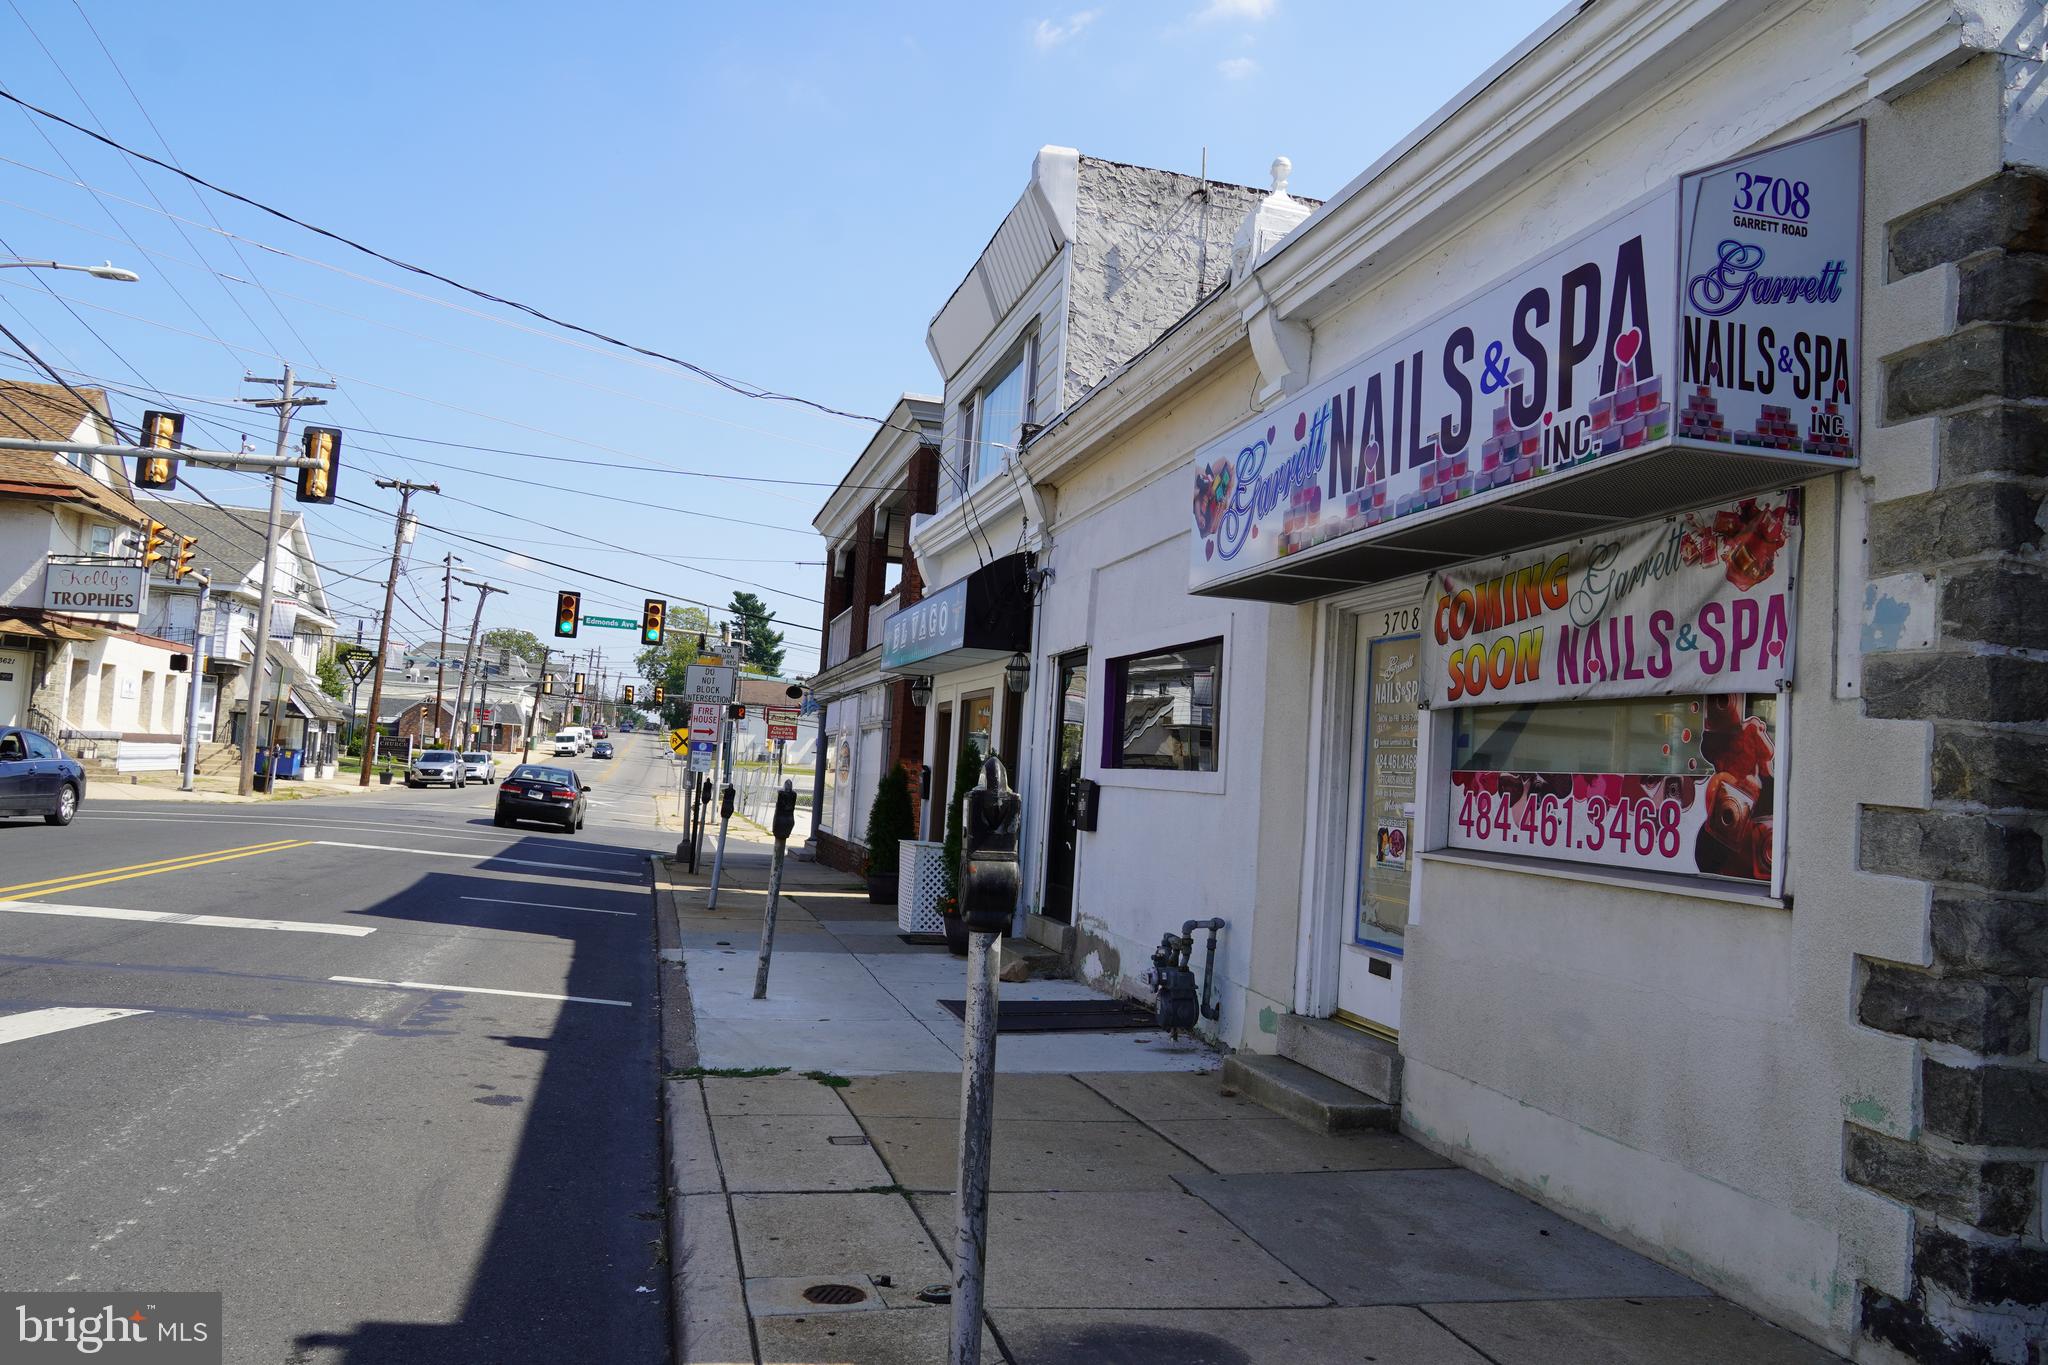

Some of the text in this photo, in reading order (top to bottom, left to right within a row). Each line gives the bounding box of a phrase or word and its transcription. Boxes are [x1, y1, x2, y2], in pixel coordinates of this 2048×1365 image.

[1733, 171, 1810, 219] 3708
[1733, 215, 1808, 238] GARRETT ROAD
[1688, 239, 1847, 317] Garrett
[1217, 398, 1332, 561] Garrett
[59, 568, 129, 592] Kelly's
[1434, 523, 1687, 646] COMING Garrett
[52, 591, 134, 608] TROPHIES
[585, 617, 635, 628] Edmonds Ave
[911, 601, 949, 643] VAGO
[1382, 607, 1421, 636] 3708
[704, 668, 715, 676] DO
[1447, 626, 1545, 701] SOON
[696, 685, 720, 694] BLOCK
[701, 677, 716, 685] NOT
[685, 693, 731, 704] INTERSECTION
[693, 715, 718, 724] HOUSE
[697, 706, 714, 716] FIRE
[1458, 790, 1682, 860] 484.461.3468
